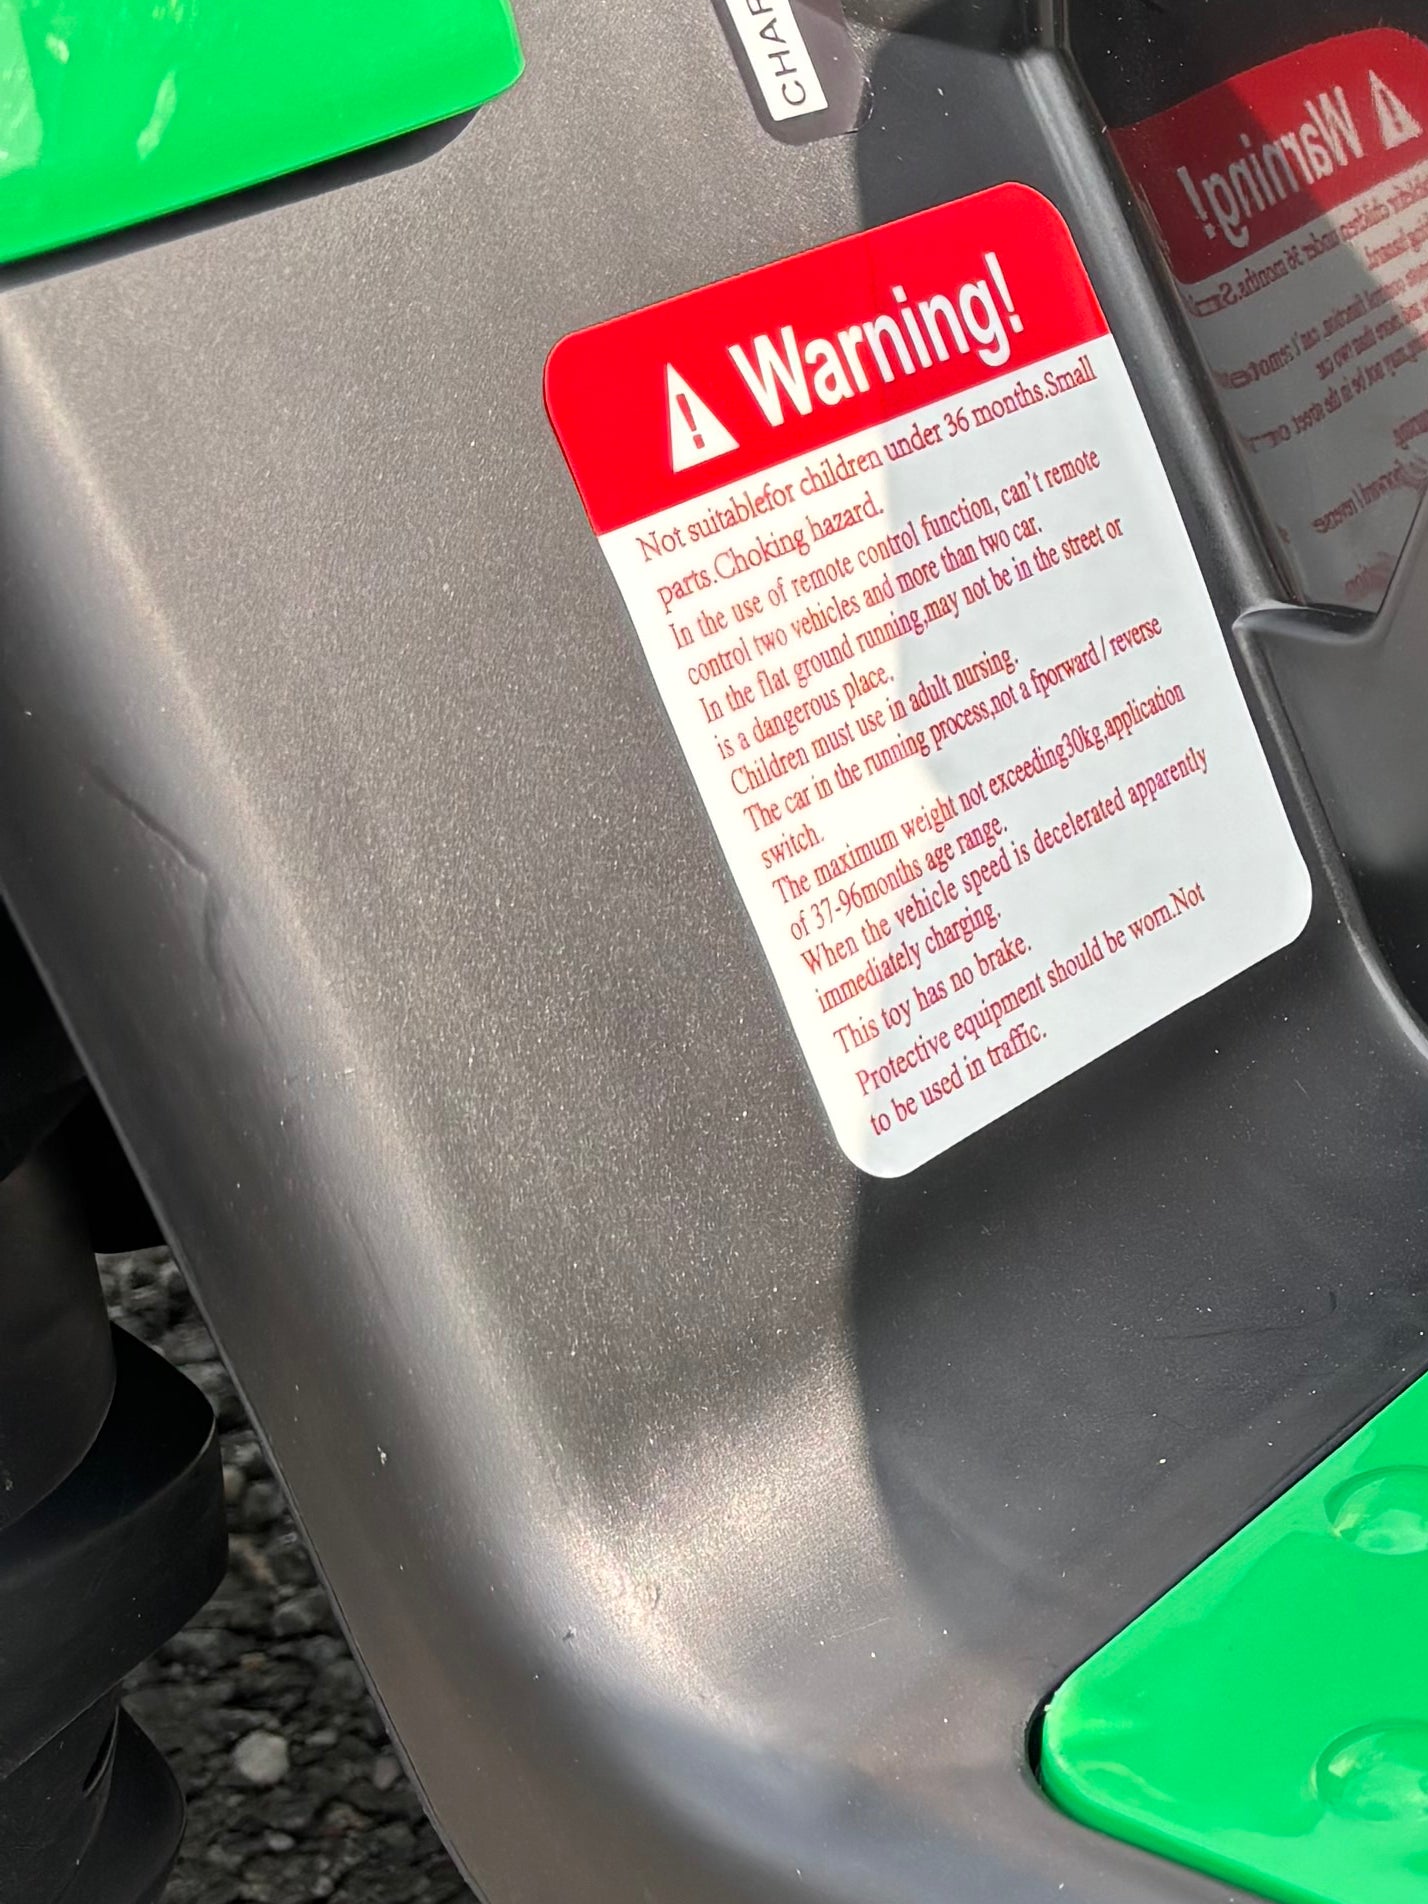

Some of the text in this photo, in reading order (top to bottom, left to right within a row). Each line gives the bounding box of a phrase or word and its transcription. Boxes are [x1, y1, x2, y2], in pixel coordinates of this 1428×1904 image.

[728, 252, 1024, 427] Warning!
[635, 353, 1098, 563] Not suitablefor children under 36 months.Small
[656, 490, 885, 616] parts.Choking hazard.
[668, 622, 696, 650] In
[696, 609, 729, 638] the
[730, 595, 764, 623] use
[767, 576, 788, 607] of
[790, 556, 855, 598] remote
[856, 520, 921, 569] control
[920, 496, 1001, 542] function,
[1043, 450, 1101, 489] remote
[687, 516, 1043, 686] control two vehicles and more than two car.
[698, 697, 725, 724] In
[725, 684, 756, 713] the
[756, 666, 791, 698] flat
[793, 632, 856, 689] ground
[960, 574, 993, 606] not
[987, 566, 1014, 592] be
[1010, 556, 1035, 583] in
[1032, 545, 1061, 573] the
[1060, 523, 1106, 561] street
[1105, 517, 1124, 540] or
[714, 666, 895, 761] is a dangerous place.
[730, 649, 1019, 795] Children must use in adult nursing.
[742, 801, 783, 832] The
[784, 786, 812, 815] car
[811, 774, 834, 801] in
[833, 762, 863, 790] the
[862, 730, 931, 777] running
[1018, 681, 1033, 701] a
[1108, 617, 1163, 657] reverse
[760, 823, 825, 870] switch.
[771, 874, 812, 904] The
[813, 829, 900, 887] maximum
[899, 795, 960, 840] weight
[957, 780, 989, 813] not
[790, 817, 1008, 941] of 37-96months age range.
[799, 746, 1208, 975] When the vehicle speed is decelerated apparently
[815, 903, 1002, 1014] immediately charging.
[832, 936, 1032, 1054] This toy has no brake.
[854, 1030, 951, 1097] Protective
[953, 972, 1047, 1042] equipment
[1046, 935, 1105, 989] should
[1101, 929, 1128, 954] be
[869, 1021, 1047, 1137] to be used in traffic.
